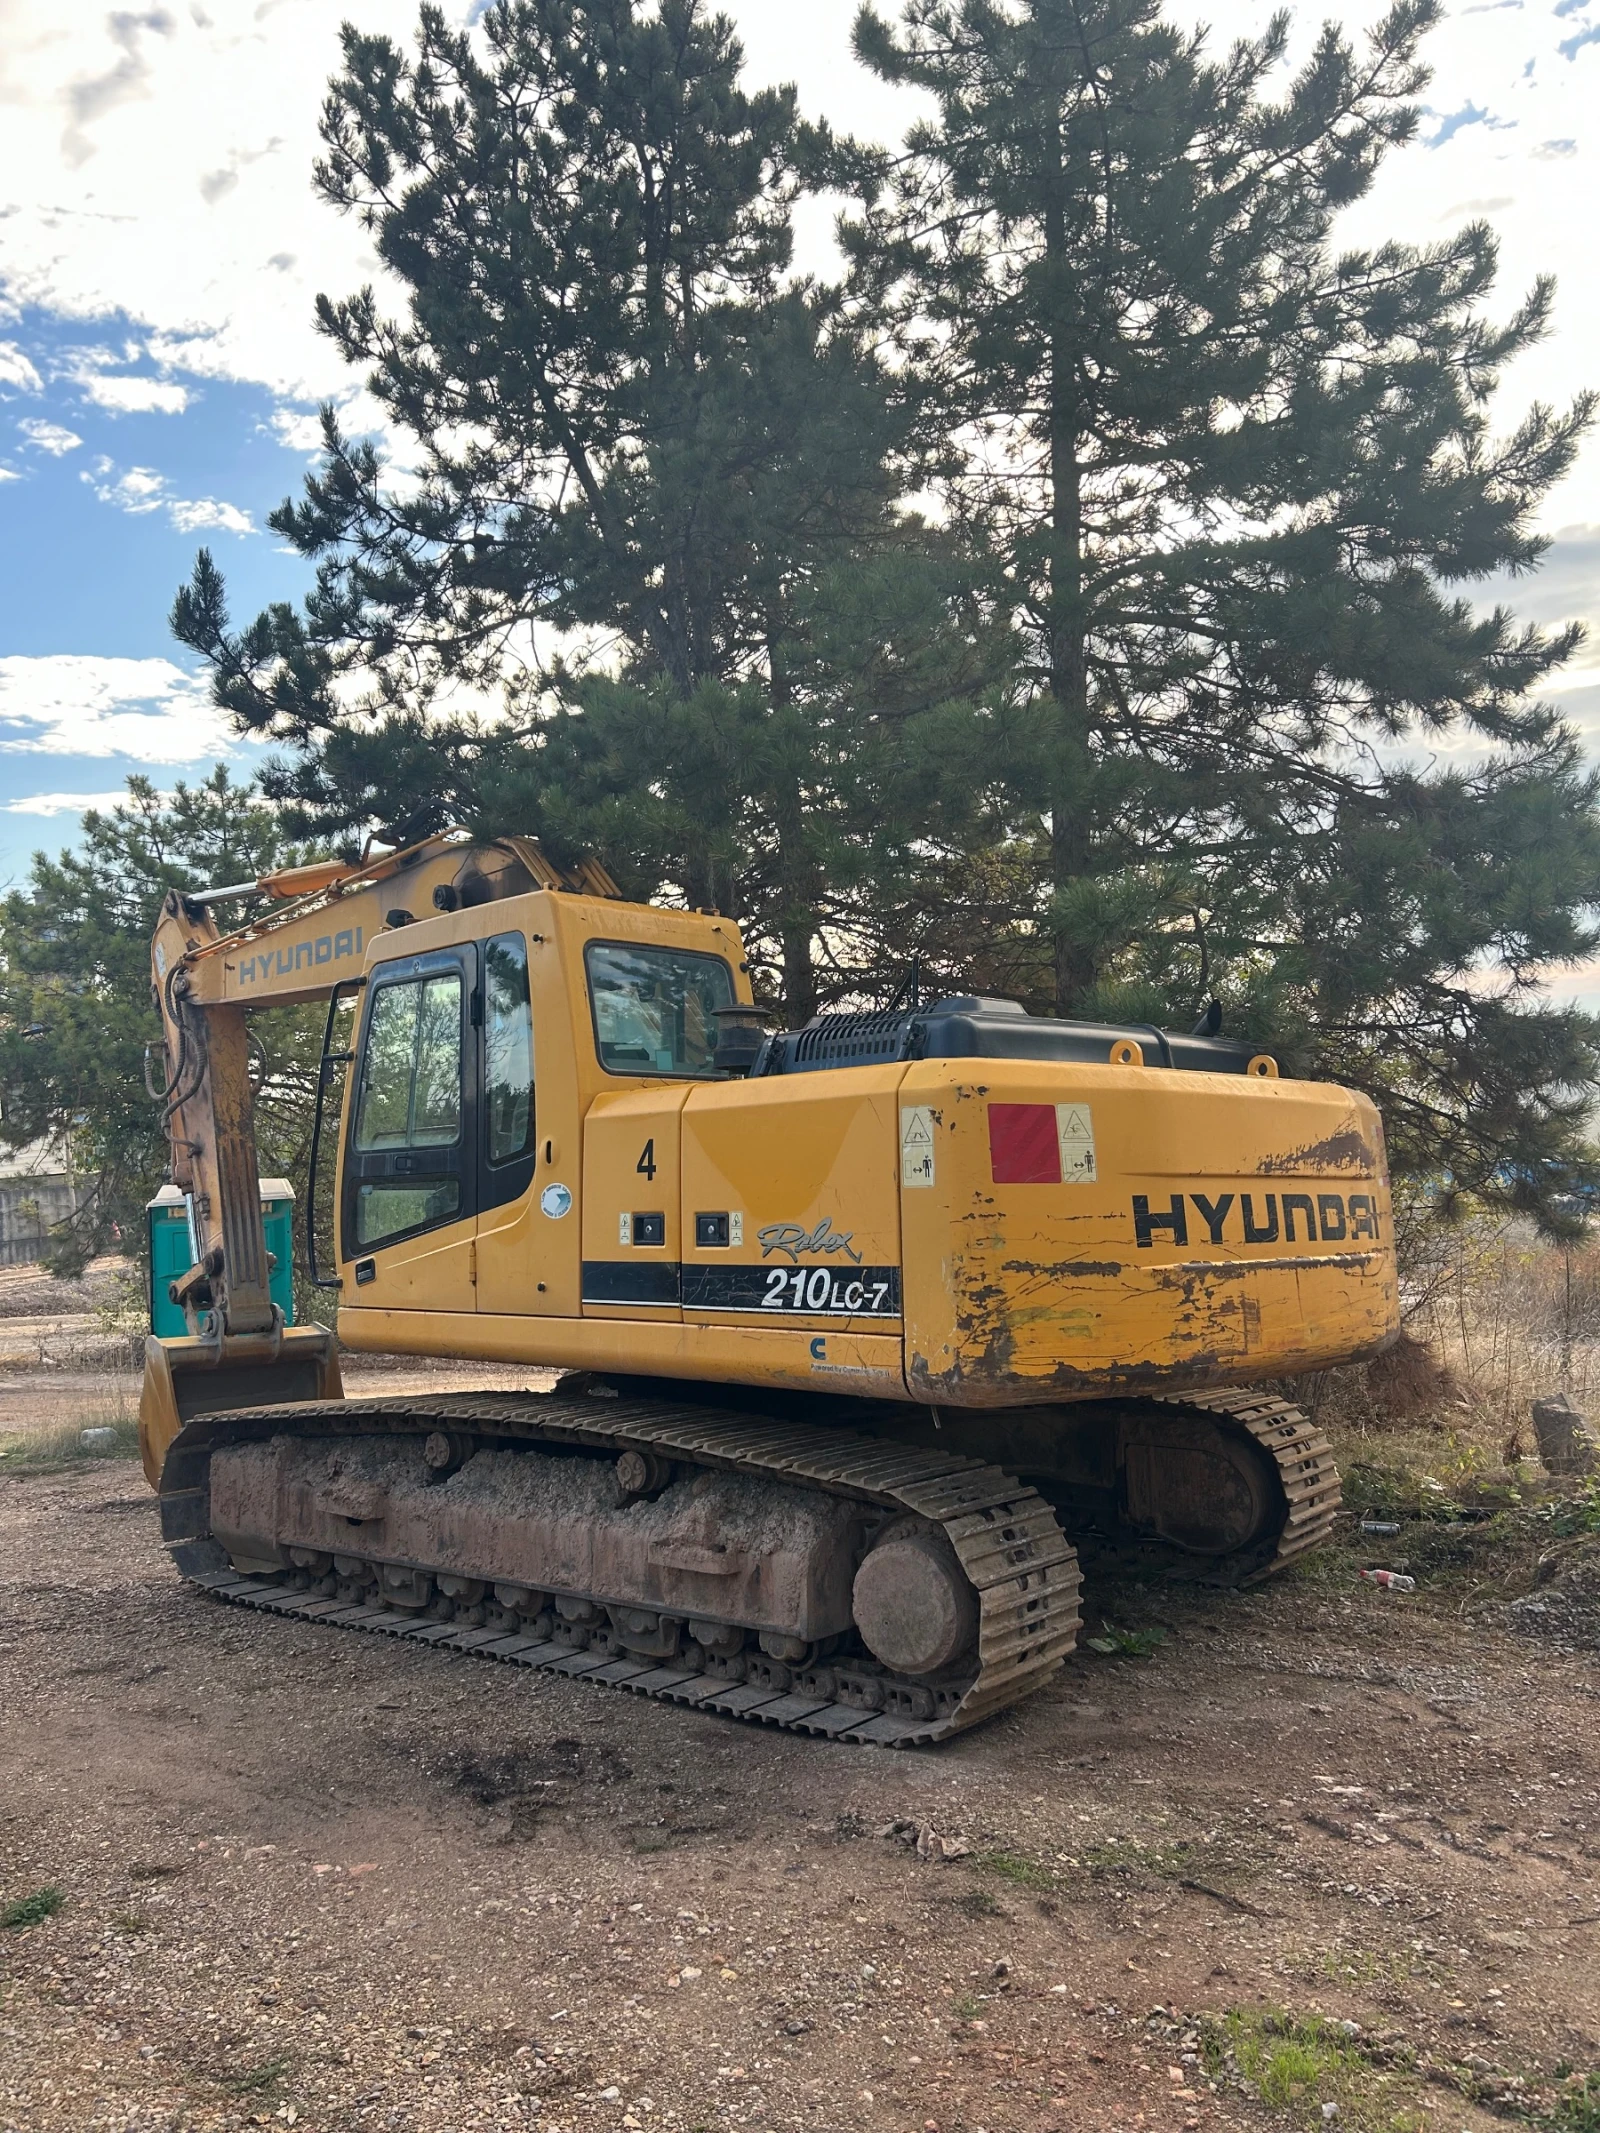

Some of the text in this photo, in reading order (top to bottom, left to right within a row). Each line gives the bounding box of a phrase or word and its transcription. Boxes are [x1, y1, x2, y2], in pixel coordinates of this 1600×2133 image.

[240, 927, 363, 985] HYUNDAI
[637, 1138, 657, 1181] 4
[757, 1217, 862, 1264] Robex
[1132, 1194, 1380, 1248] HYUNDAI
